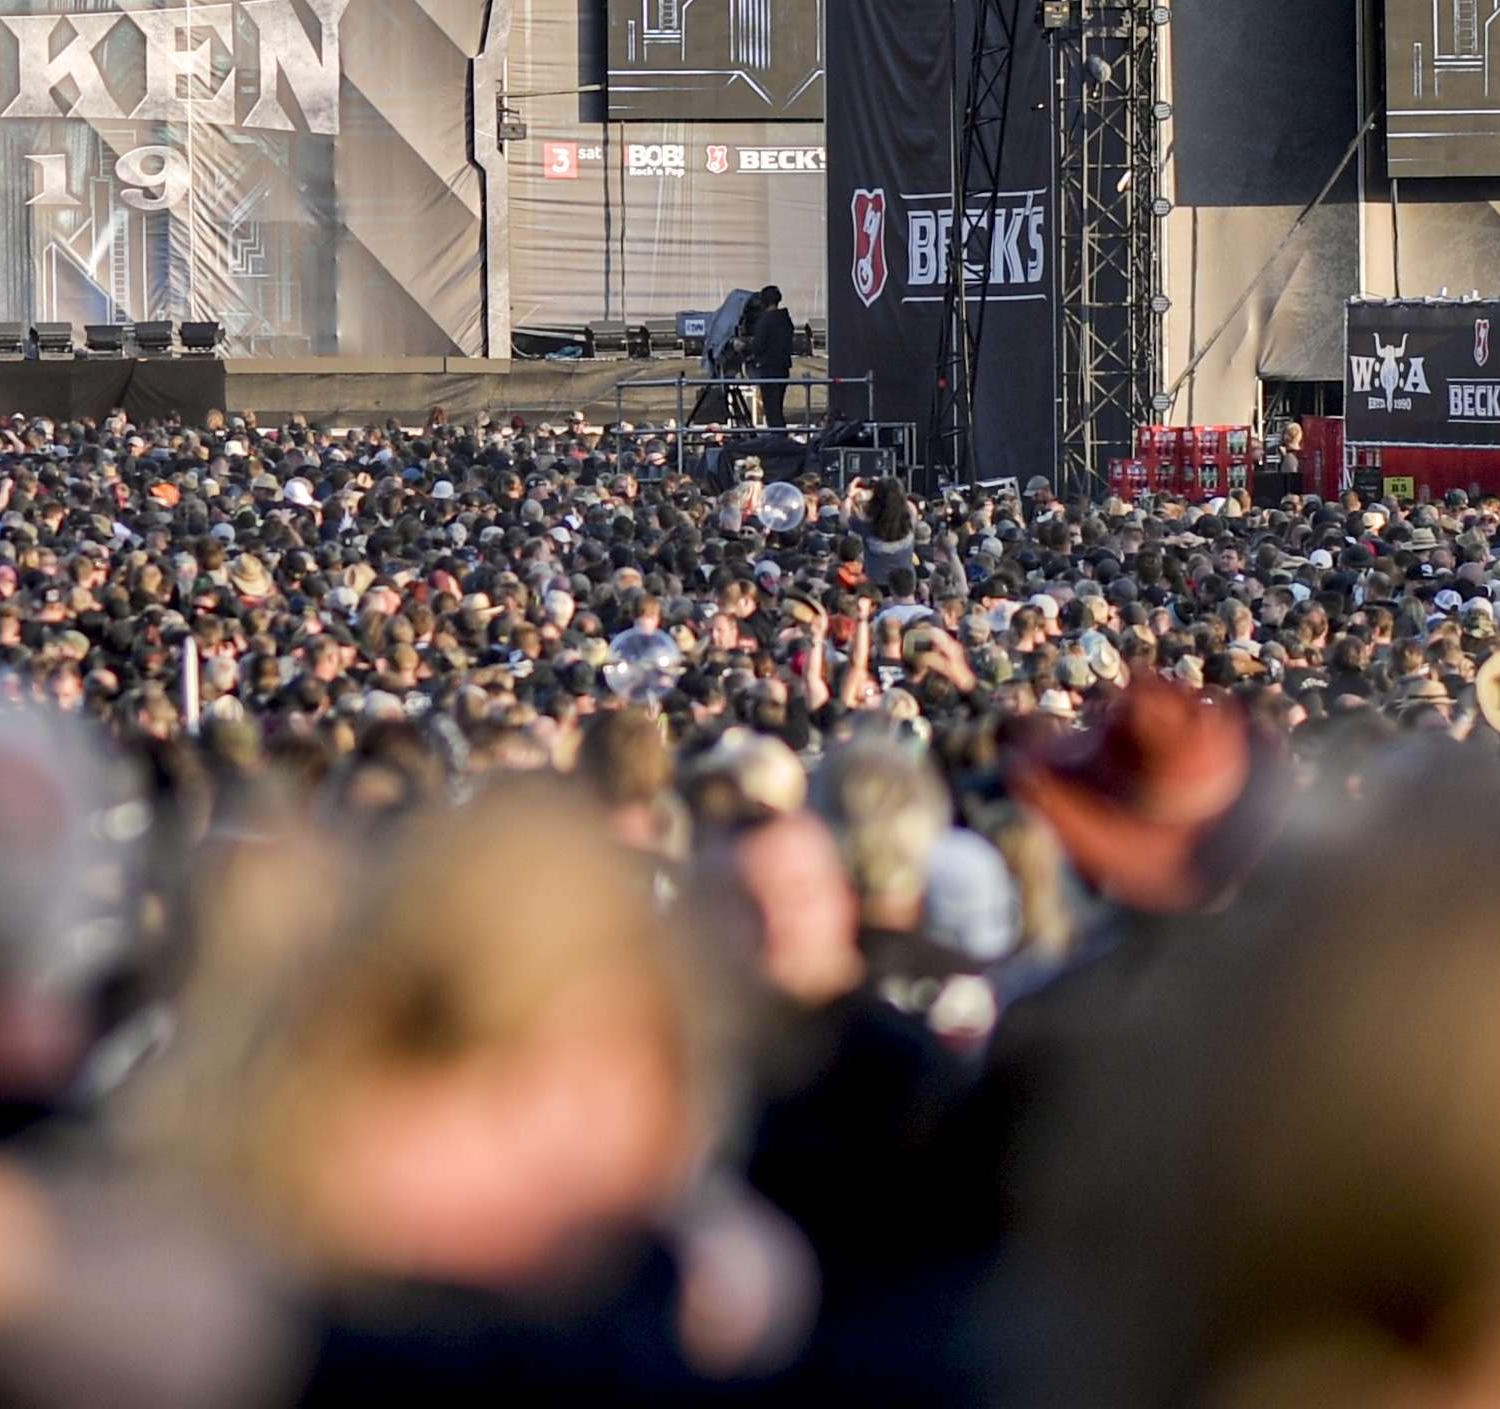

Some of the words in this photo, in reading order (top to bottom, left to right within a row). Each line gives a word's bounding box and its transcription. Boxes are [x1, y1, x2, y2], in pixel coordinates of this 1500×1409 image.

[629, 145, 685, 166] BOB!
[739, 149, 826, 170] BECK'
[665, 168, 685, 177] Pop
